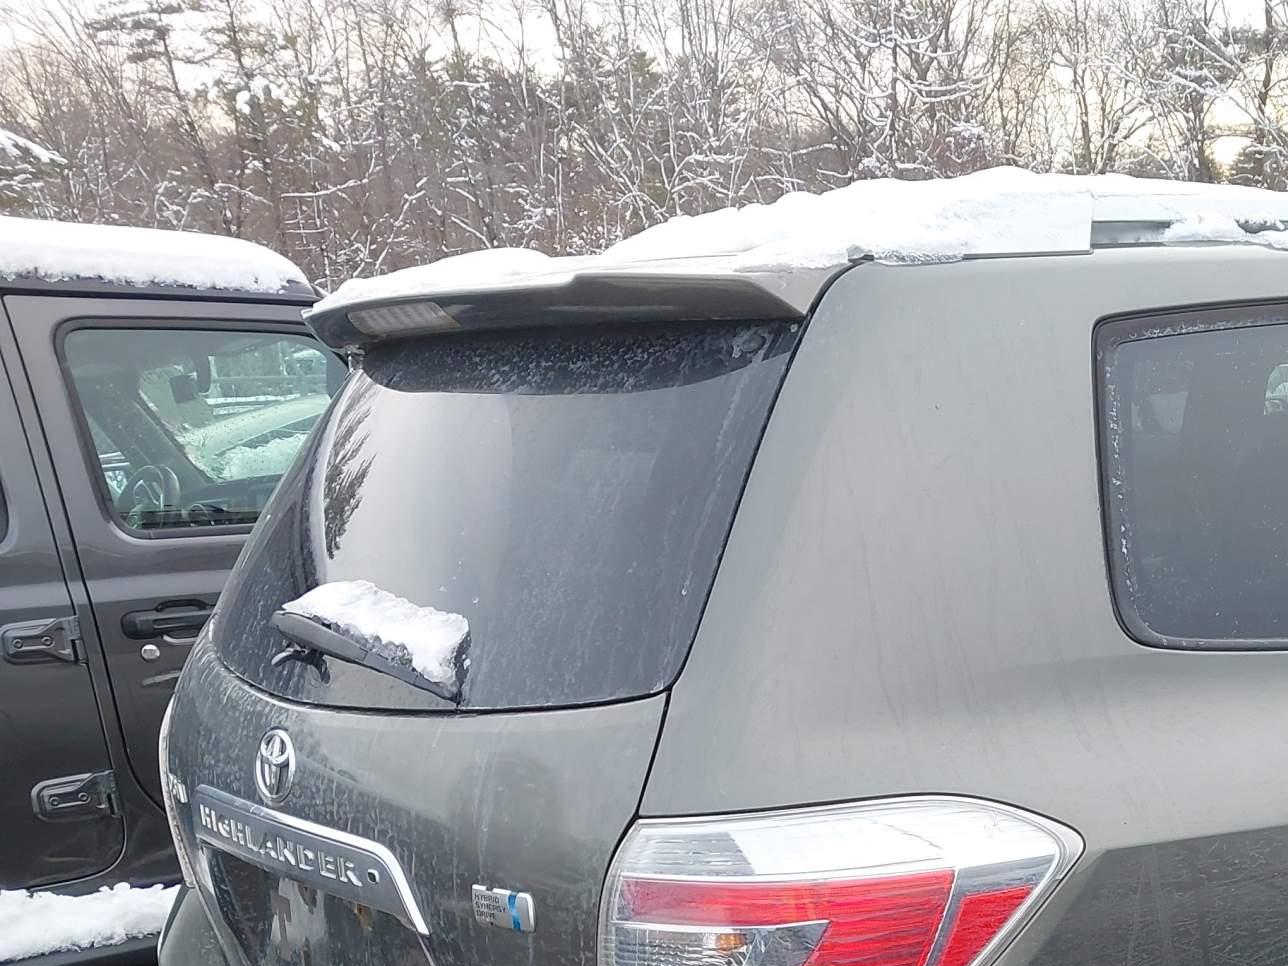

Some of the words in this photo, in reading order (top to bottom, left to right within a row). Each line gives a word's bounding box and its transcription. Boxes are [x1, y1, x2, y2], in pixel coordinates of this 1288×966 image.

[199, 803, 363, 888] HIGHLANDER
[474, 892, 500, 904] HYBRID
[474, 900, 506, 913] SYNERGY
